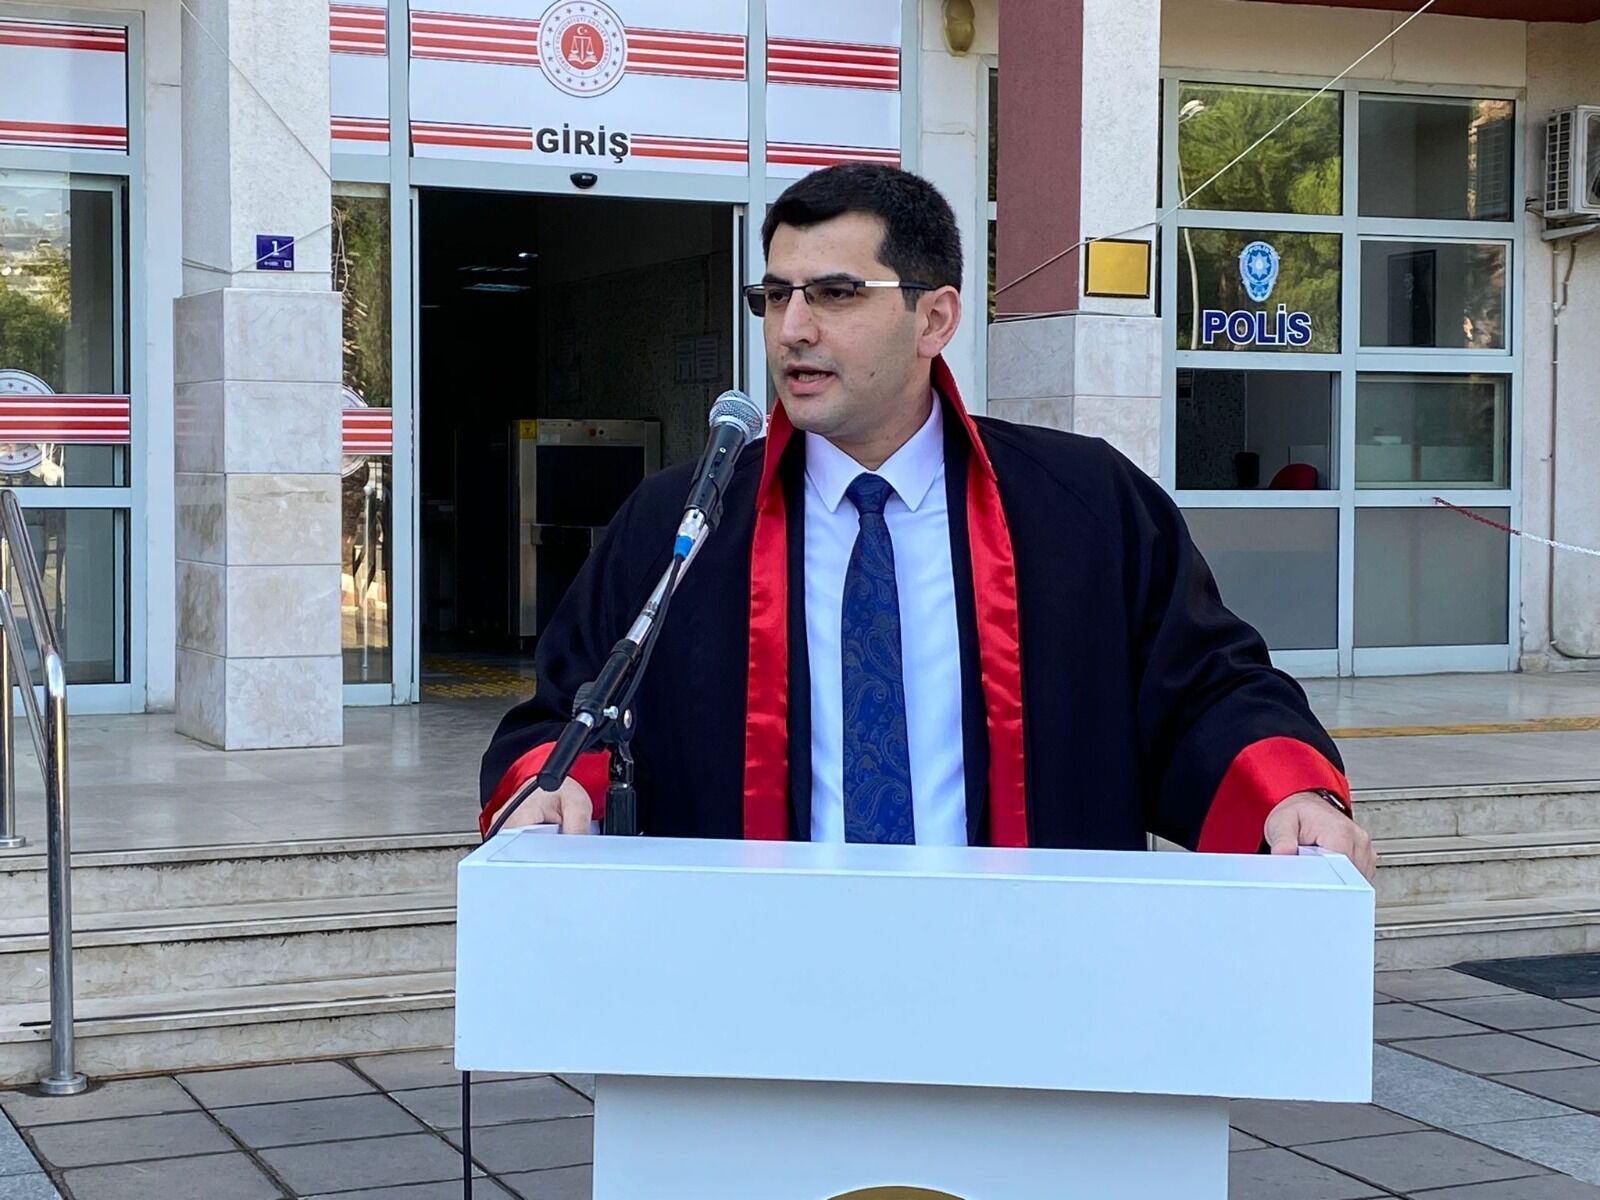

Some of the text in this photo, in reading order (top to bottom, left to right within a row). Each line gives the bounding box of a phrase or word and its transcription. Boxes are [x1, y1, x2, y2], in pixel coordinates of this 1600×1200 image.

[536, 123, 629, 164] GİRİŞ
[272, 240, 280, 256] 1
[1203, 303, 1312, 346] POLİS
